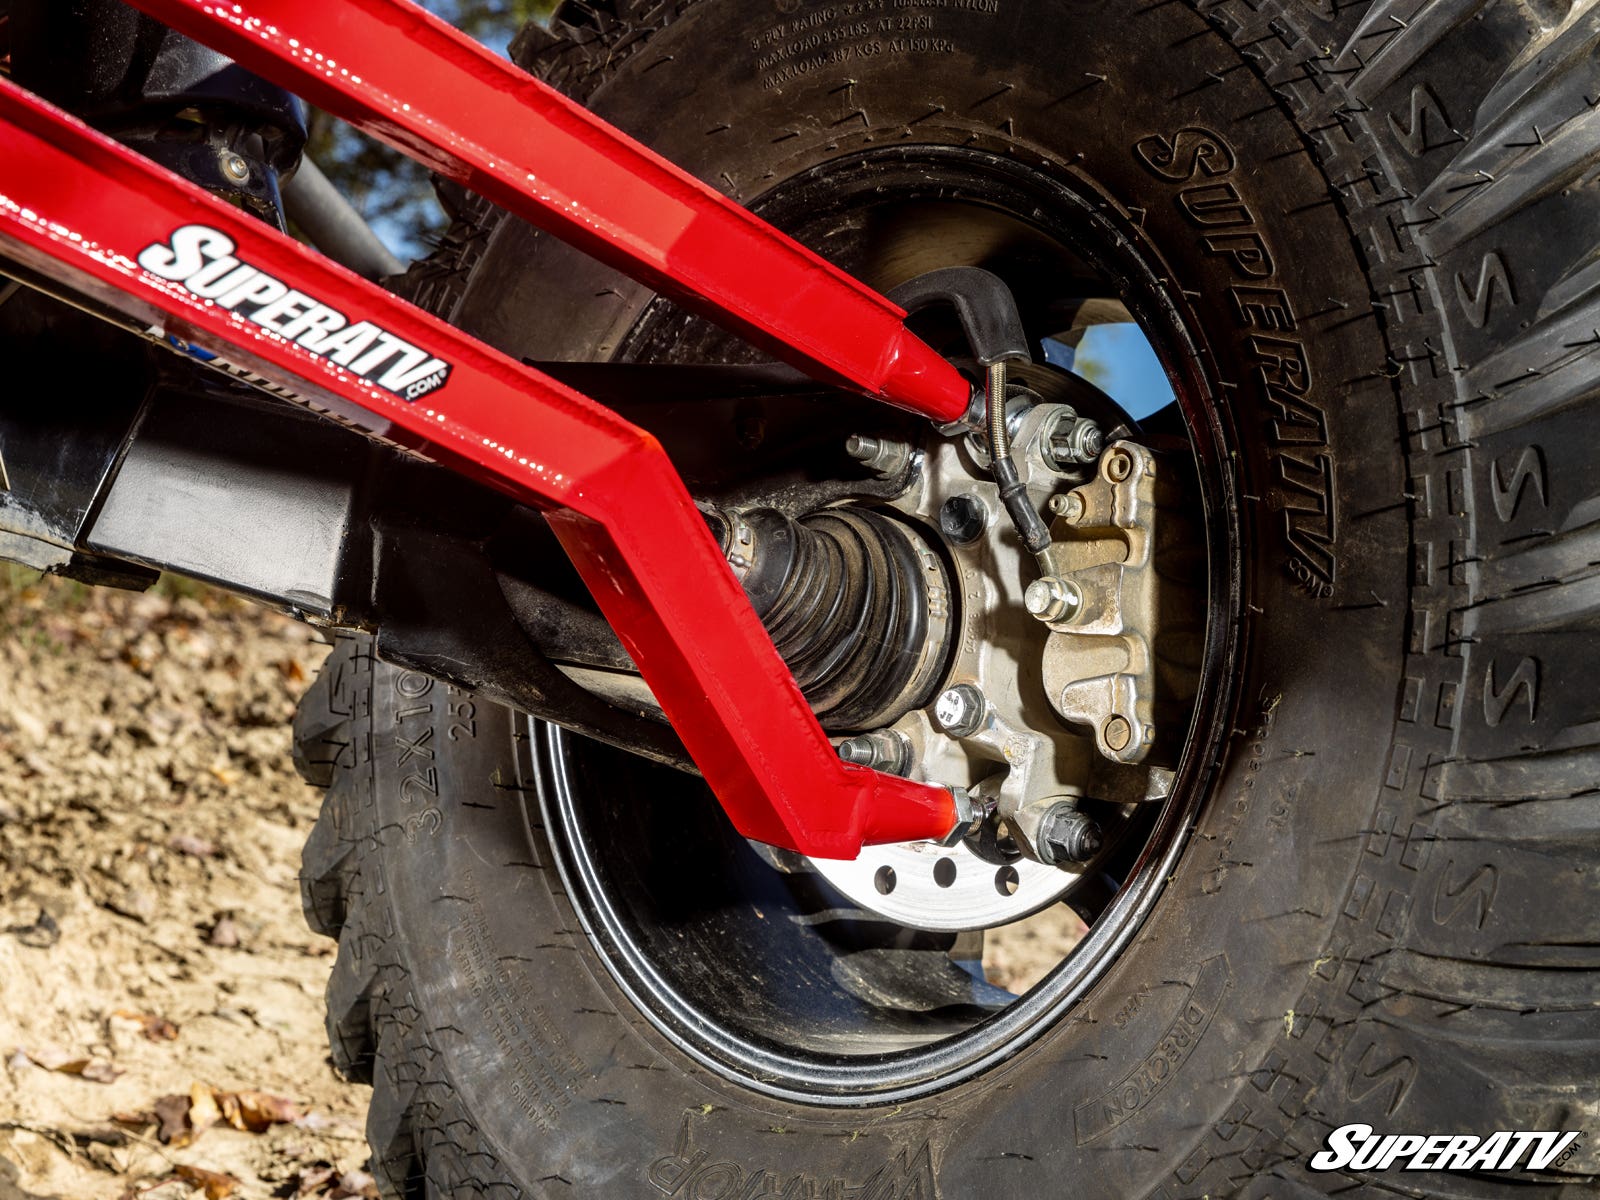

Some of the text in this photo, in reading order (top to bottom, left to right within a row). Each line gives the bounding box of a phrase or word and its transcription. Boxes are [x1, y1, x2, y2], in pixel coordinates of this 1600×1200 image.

[752, 37, 761, 52] 8
[764, 24, 785, 45] PLY
[790, 8, 838, 33] RATING
[854, 42, 882, 58] KGS
[137, 224, 449, 394] SUPERATV
[1137, 126, 1337, 584] SUPERATV
[1103, 1000, 1207, 1125] DIRECTION
